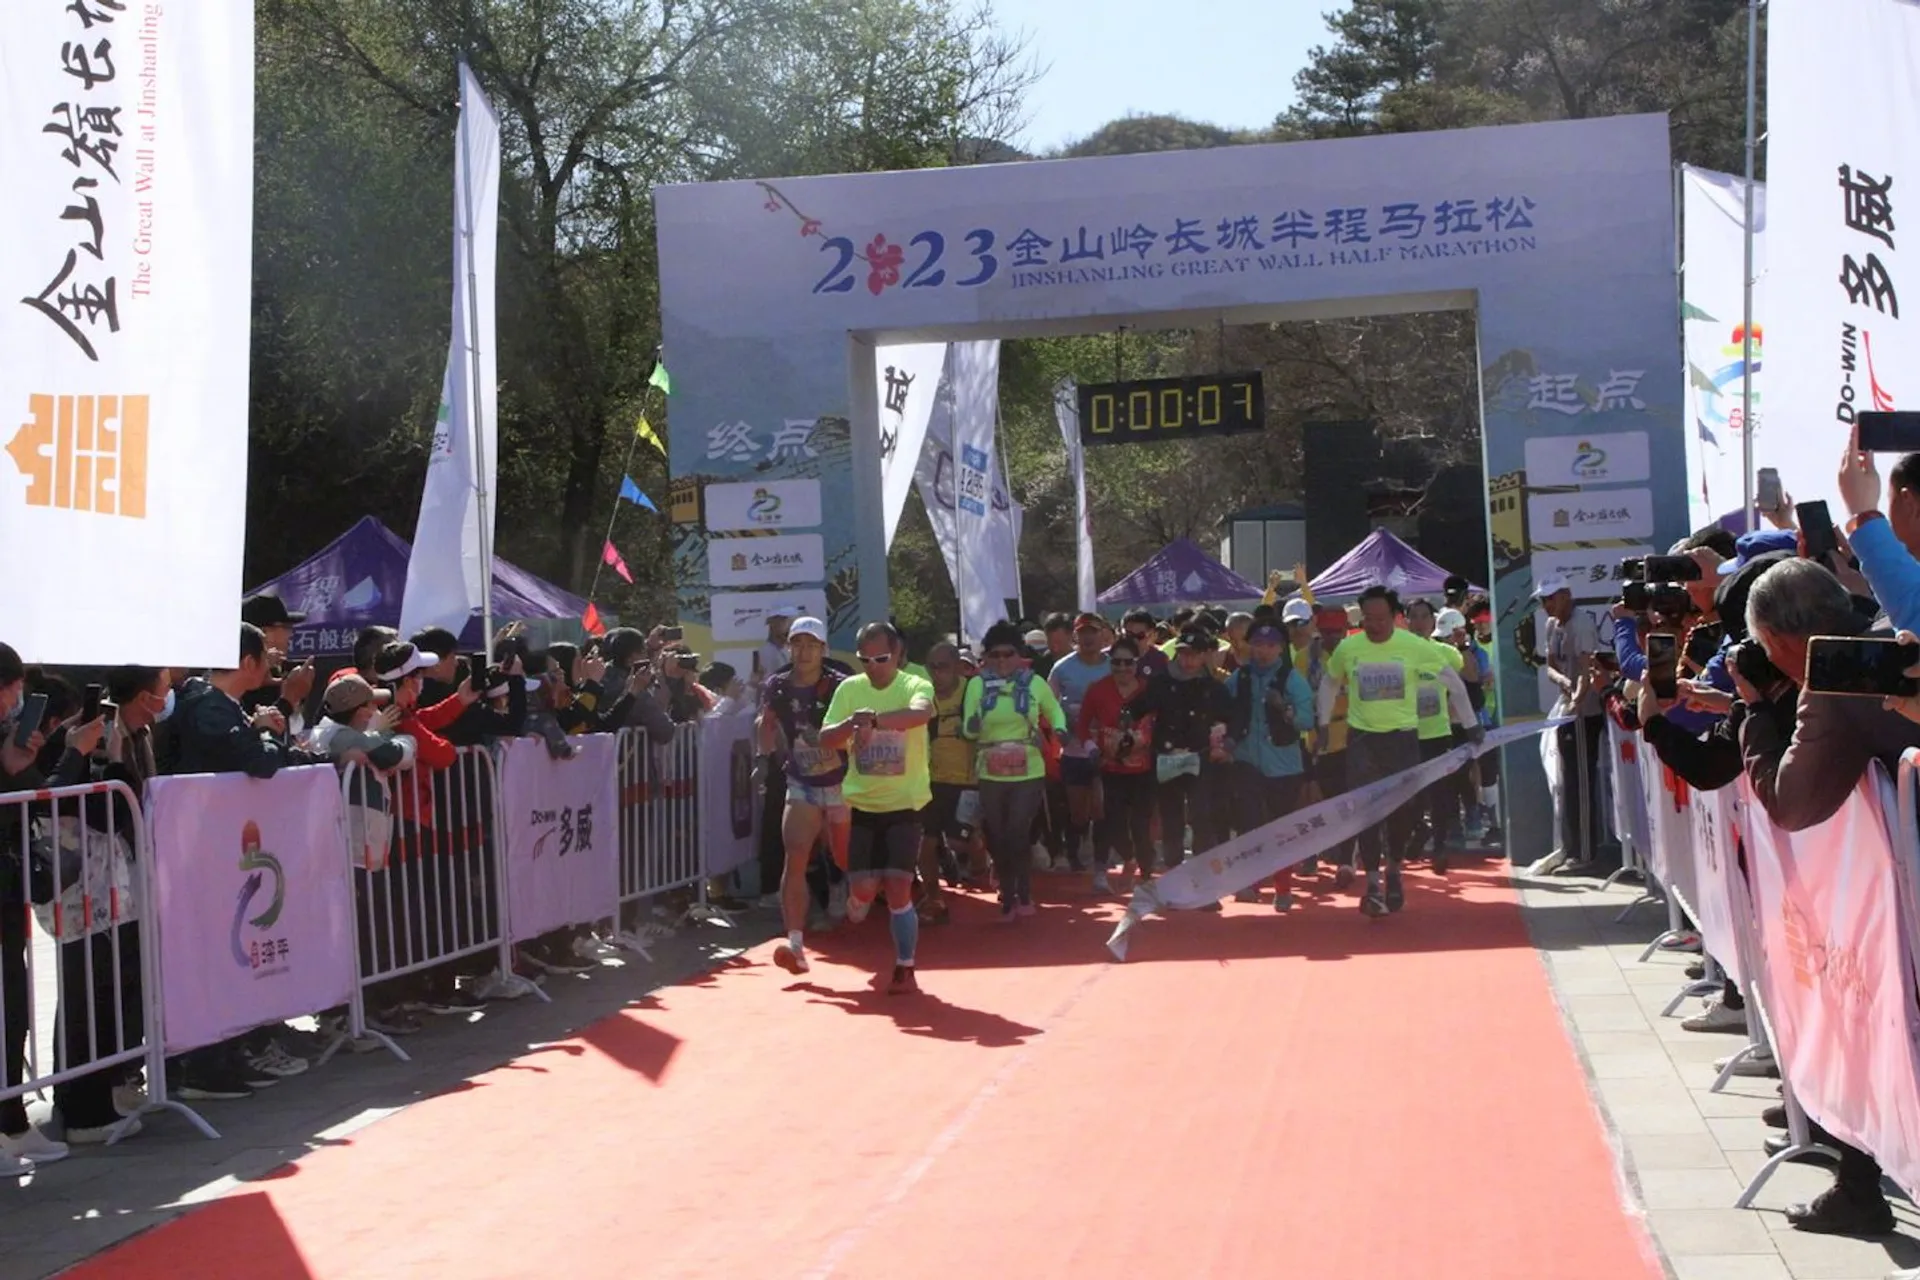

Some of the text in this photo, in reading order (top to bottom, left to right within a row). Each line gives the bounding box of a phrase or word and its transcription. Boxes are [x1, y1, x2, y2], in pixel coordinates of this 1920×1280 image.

[131, 4, 163, 300] The Great Wall at Jinshanling
[1005, 195, 1537, 267] 金山岭长城半程马拉松
[1838, 162, 1900, 320] 多威
[1011, 235, 1537, 289] JINSHANLING GREAT WALL HALF MARATHON
[1091, 383, 1253, 434] 0:00:07
[1527, 369, 1647, 416] 起点
[706, 418, 821, 462] 终点
[559, 802, 593, 857] 多威
